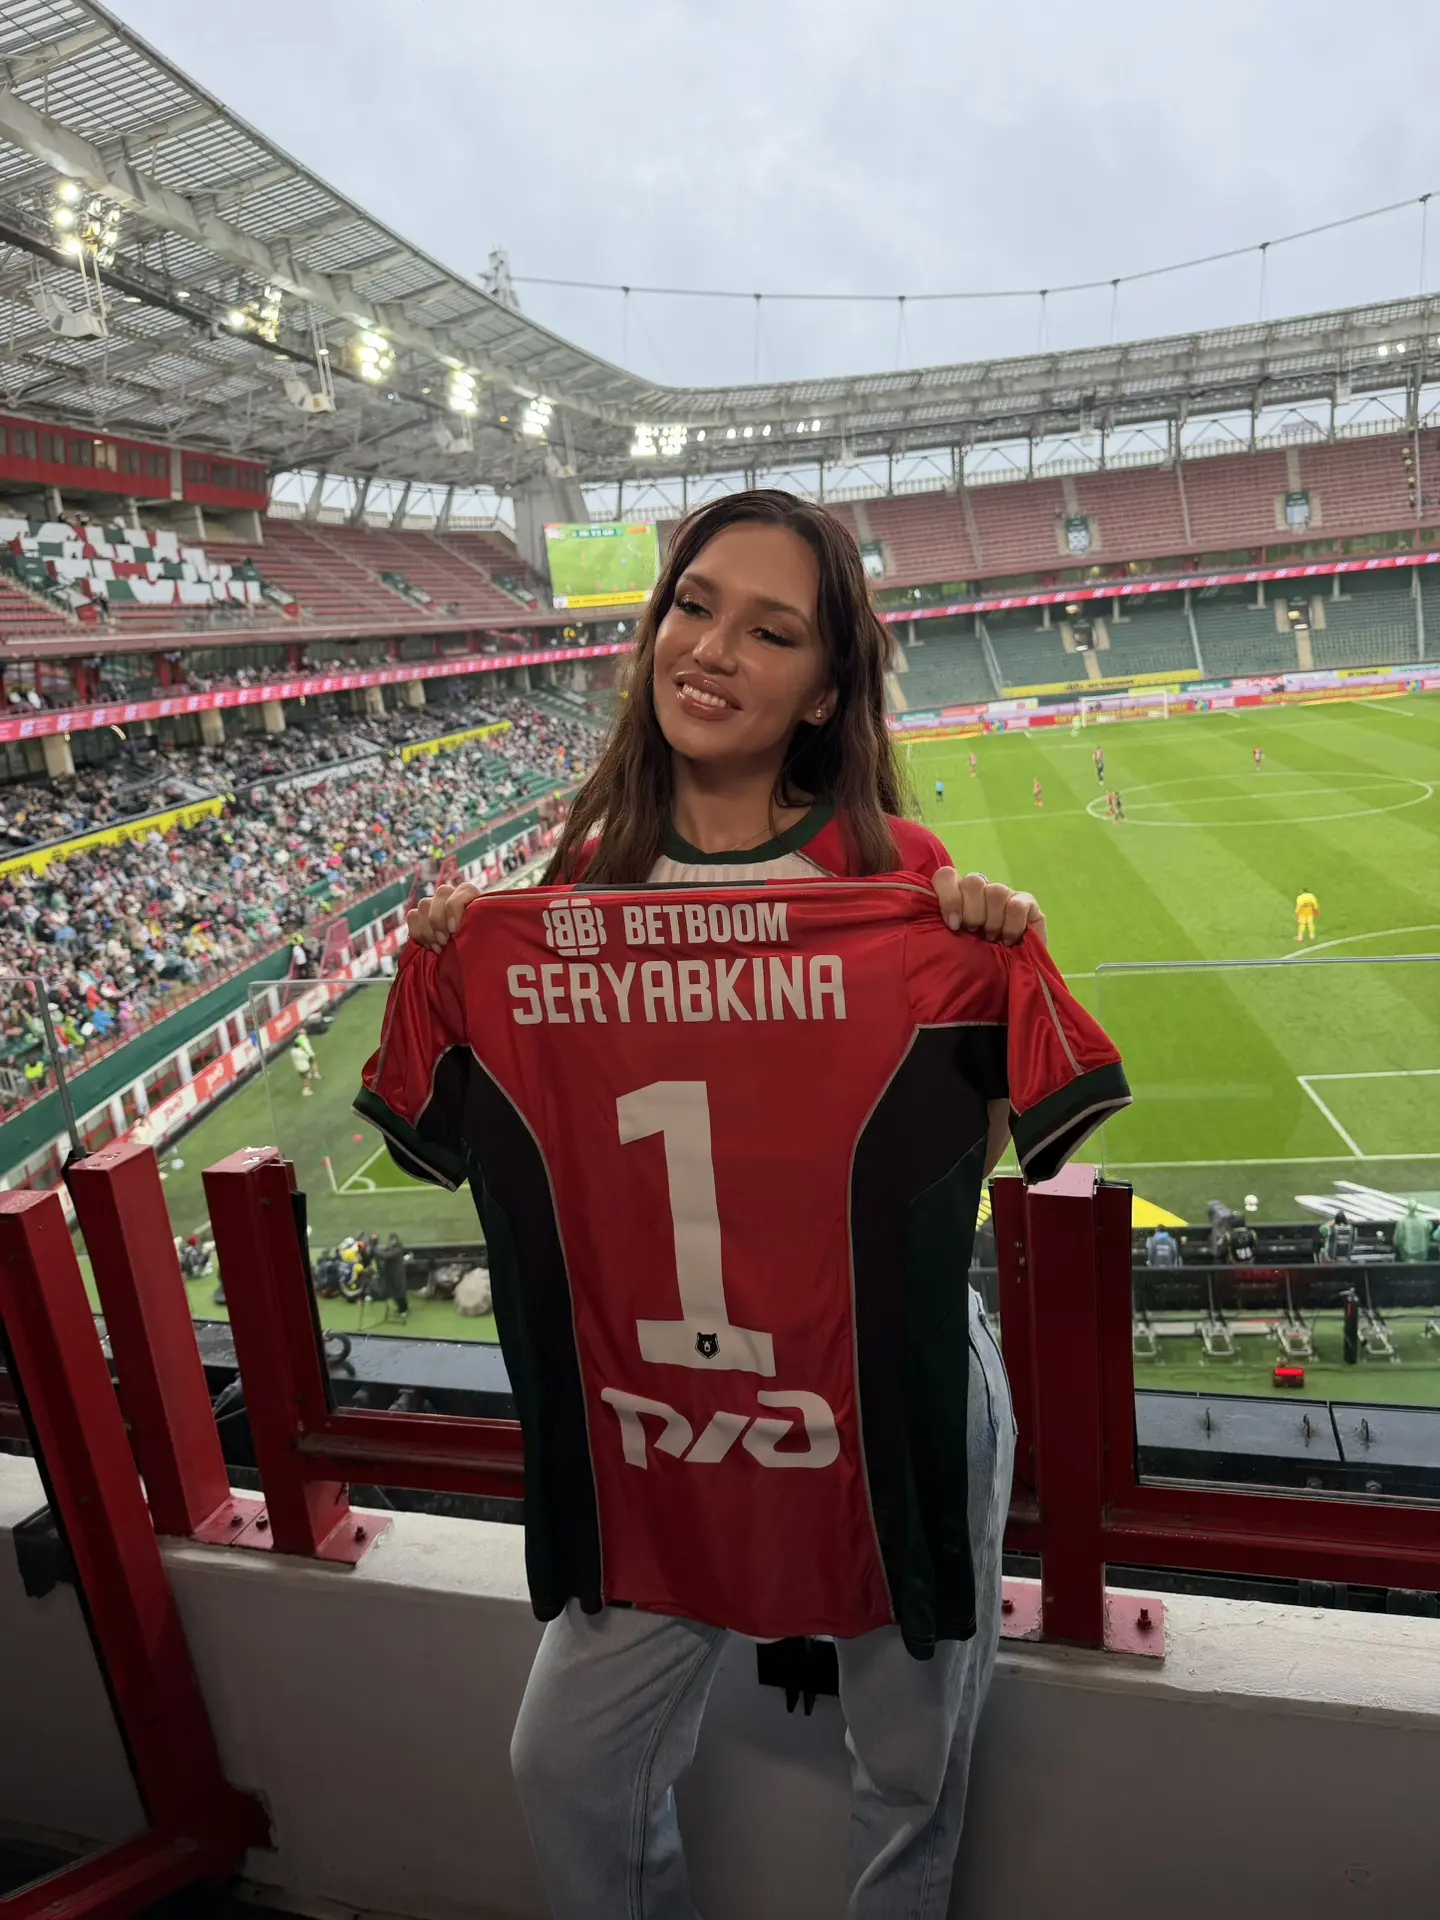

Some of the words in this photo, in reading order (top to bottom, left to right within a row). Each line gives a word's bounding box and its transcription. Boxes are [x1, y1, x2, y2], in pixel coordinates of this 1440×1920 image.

[622, 902, 790, 946] BETBOOM
[506, 954, 847, 1026] SERYABKINA
[615, 1080, 777, 1378] 1
